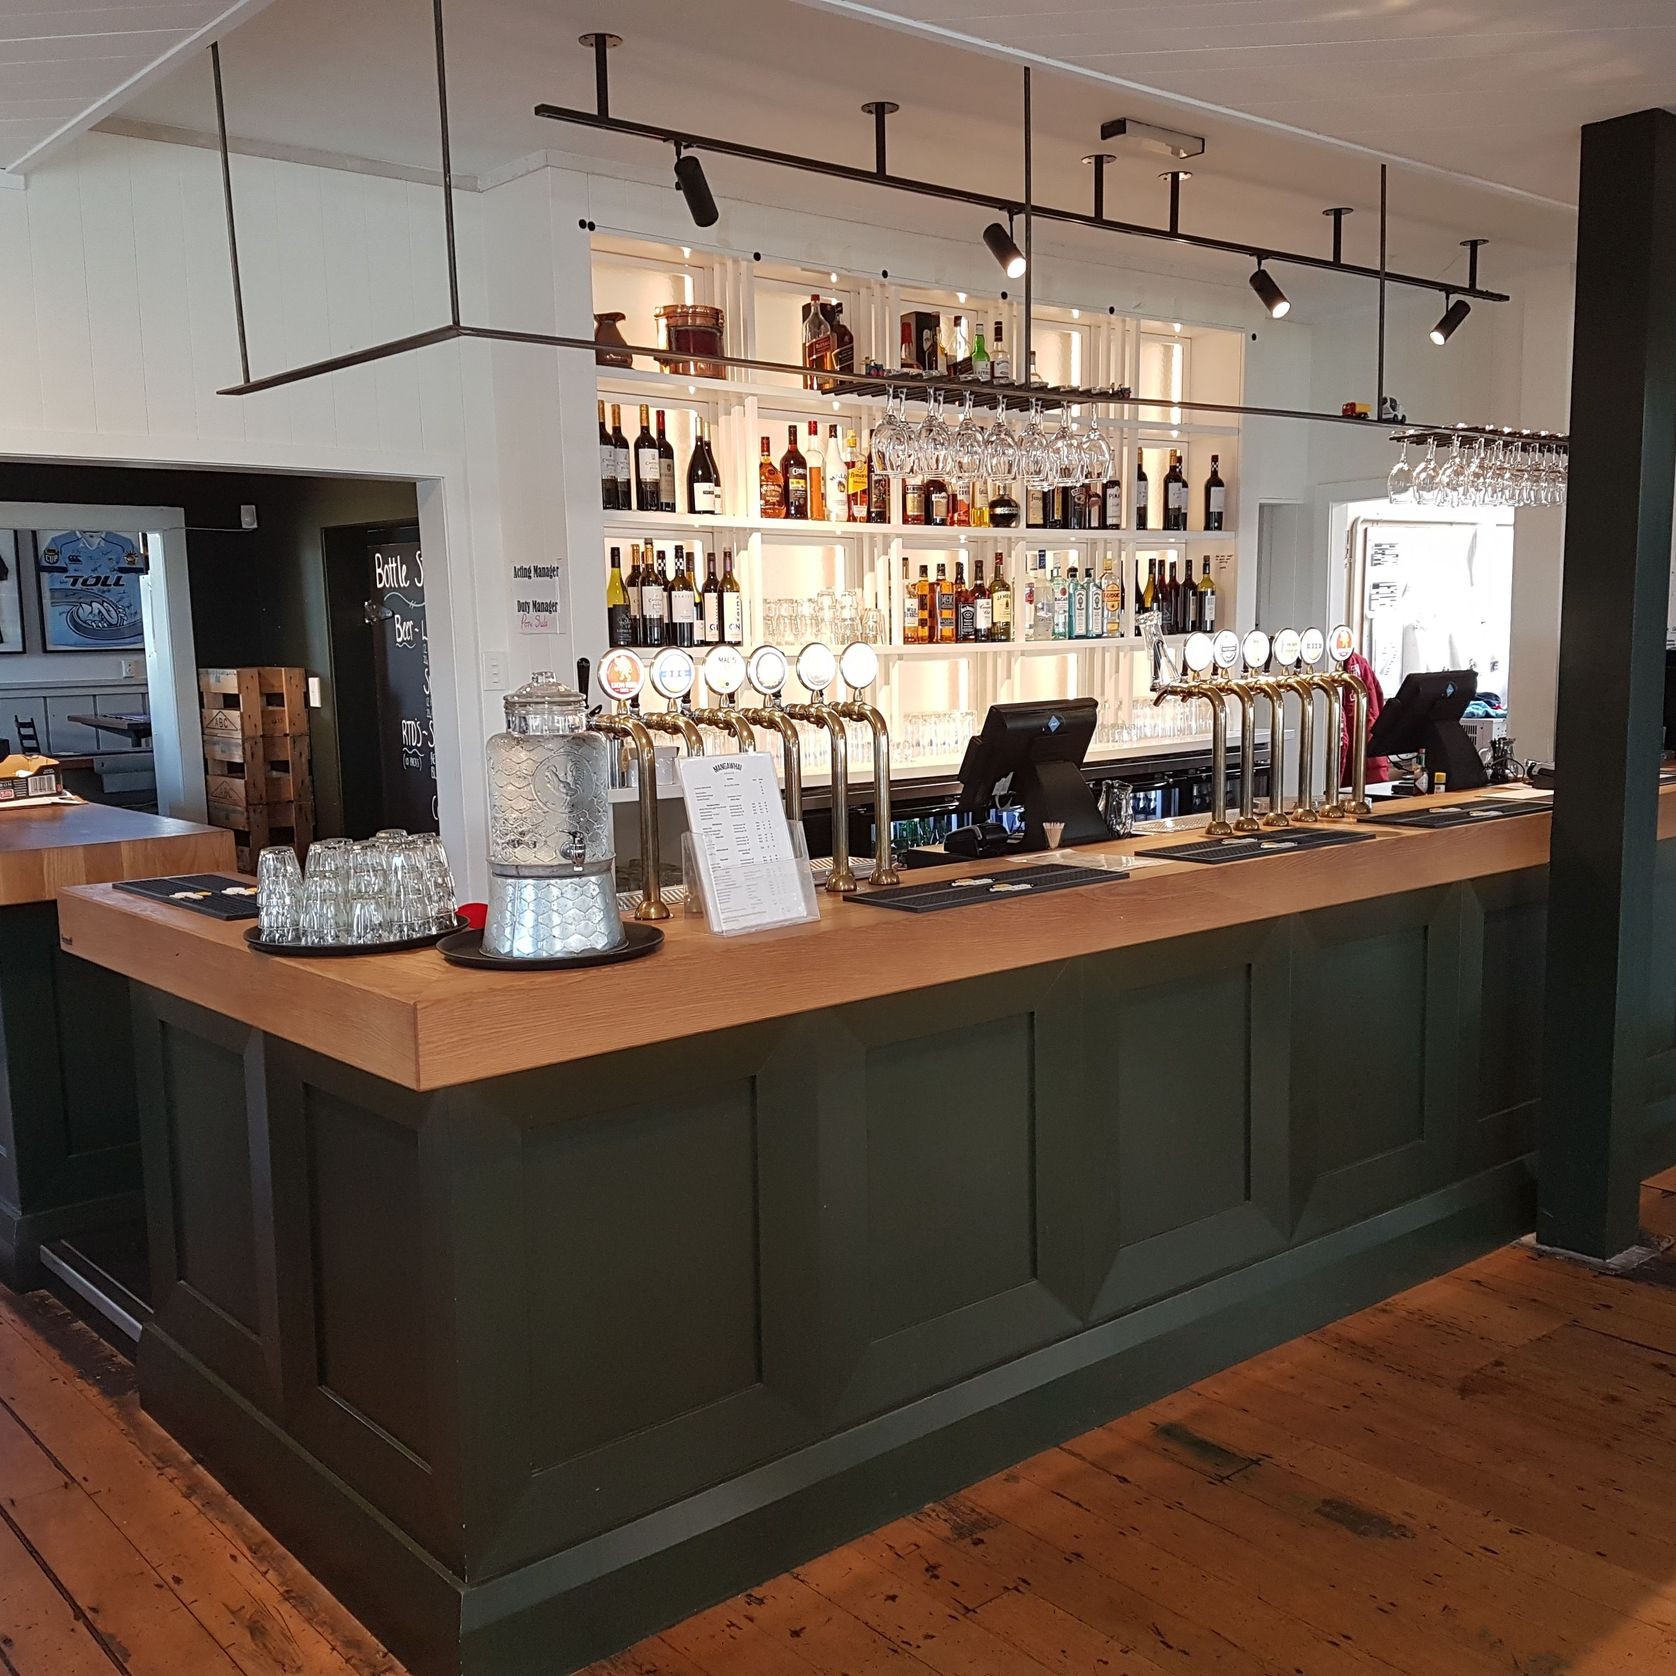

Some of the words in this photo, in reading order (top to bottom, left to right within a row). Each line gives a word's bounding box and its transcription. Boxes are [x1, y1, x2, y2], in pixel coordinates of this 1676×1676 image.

[45, 555, 58, 563] CUP
[375, 553, 409, 588] Bottle
[514, 565, 532, 579] Acting
[533, 565, 559, 579] Manager
[64, 575, 126, 587] TOLL
[517, 600, 531, 614] Duty
[532, 600, 558, 614] Manager
[214, 718, 229, 729] ABC
